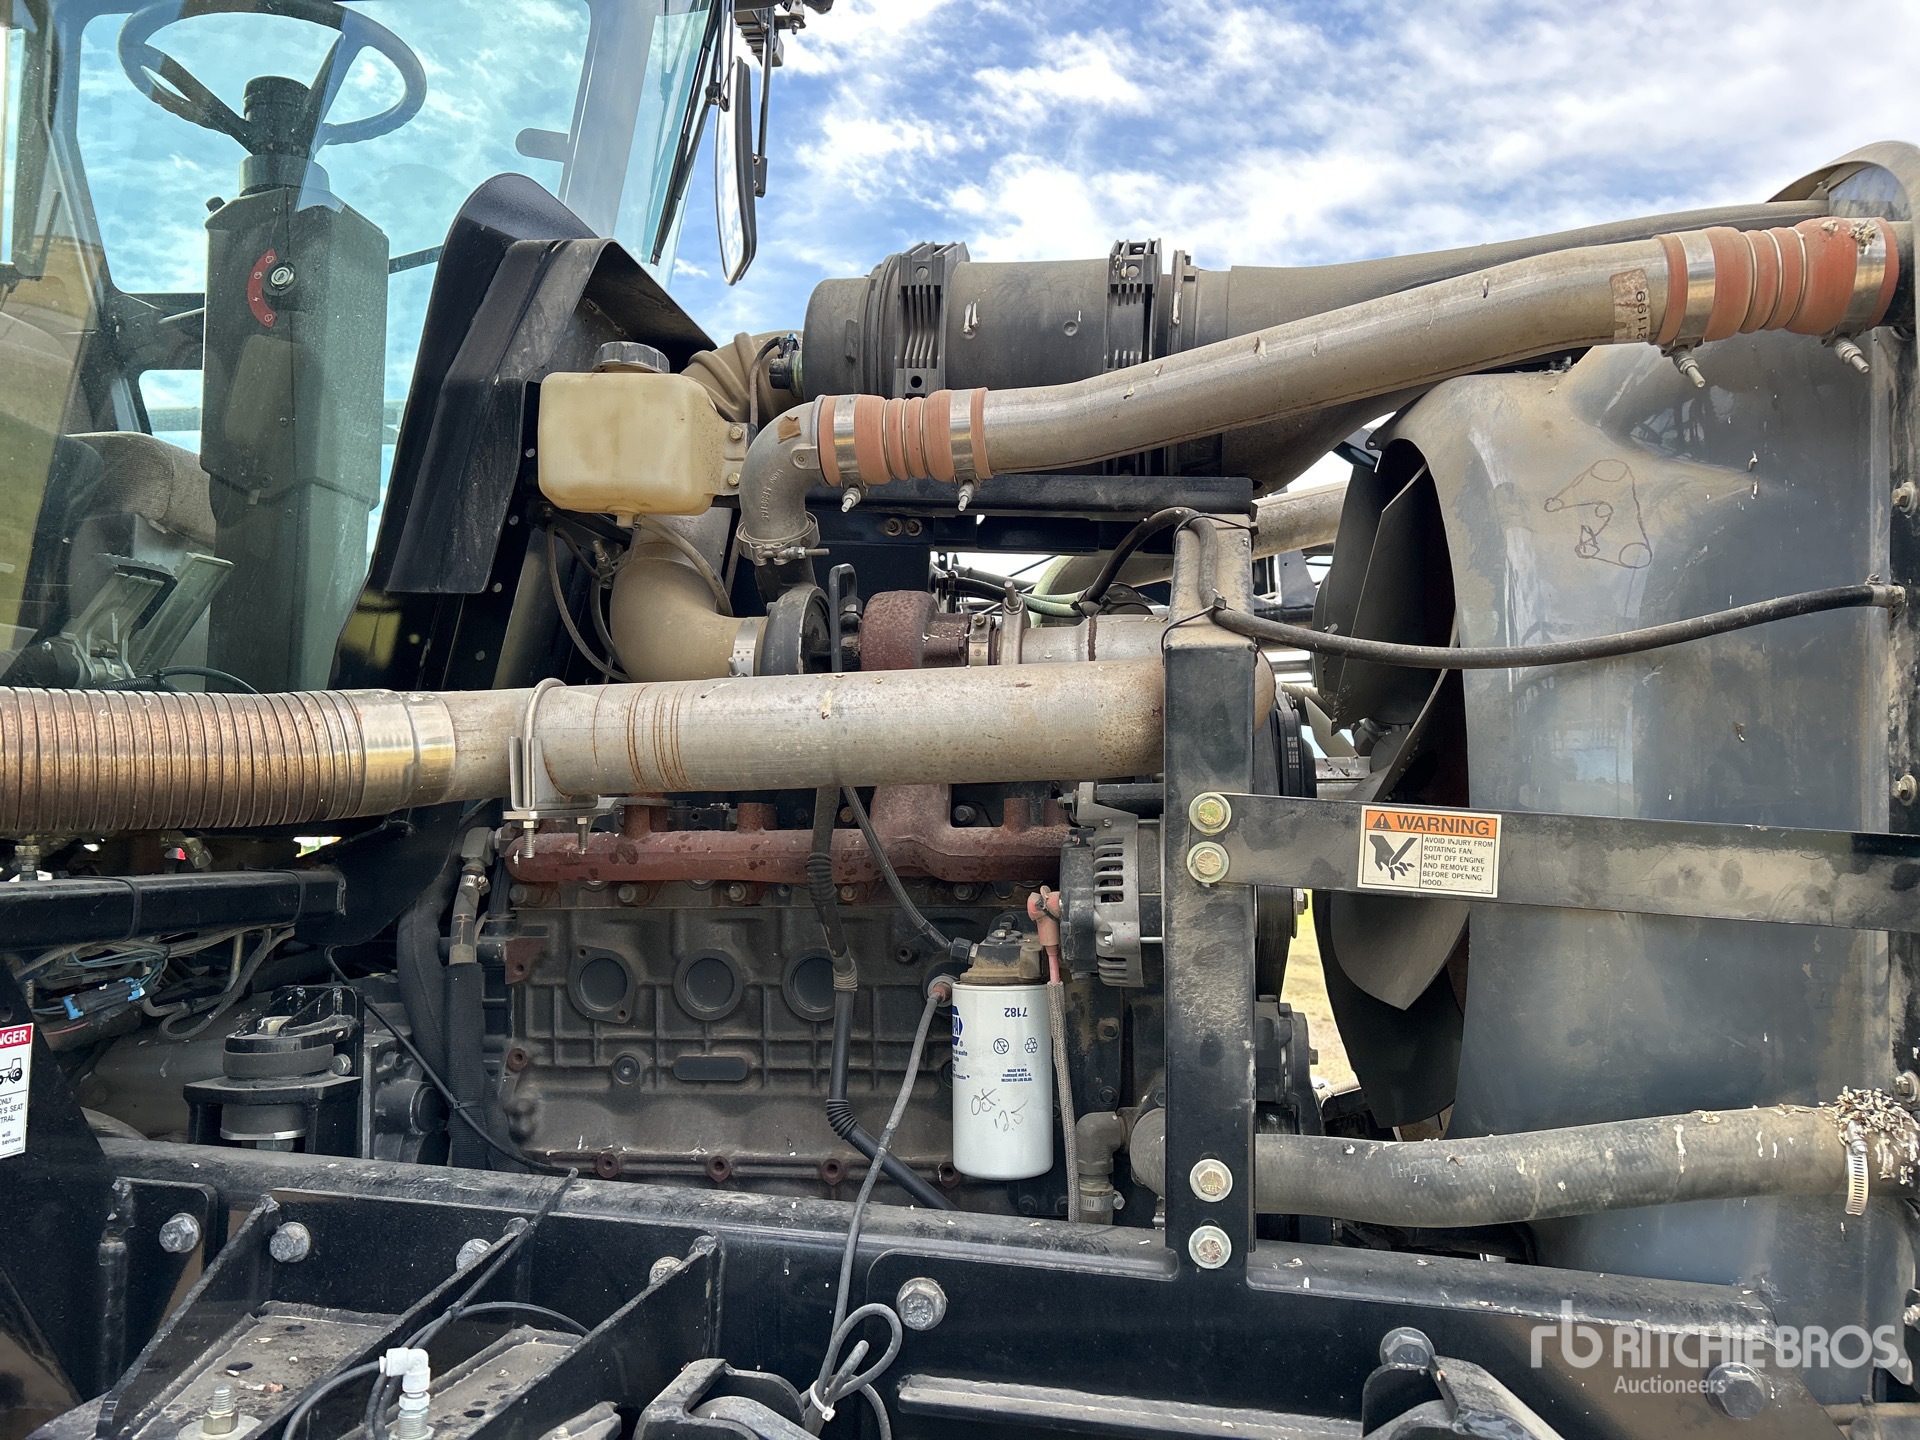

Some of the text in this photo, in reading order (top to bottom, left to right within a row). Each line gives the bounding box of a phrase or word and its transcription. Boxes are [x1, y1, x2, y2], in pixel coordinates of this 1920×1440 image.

[1636, 290, 1648, 339] 21199
[1396, 815, 1489, 836] WARNING
[1448, 838, 1472, 846] INJURY
[1474, 840, 1493, 848] FROM
[1423, 845, 1457, 854] ROTATING
[1460, 856, 1485, 864] ENGINE
[1440, 863, 1469, 872] REMOVE
[1422, 870, 1482, 881] BEFORE OPENING
[1004, 1007, 1028, 1018] 7182
[10, 1103, 23, 1113] SEAT
[2, 1136, 21, 1145] serious
